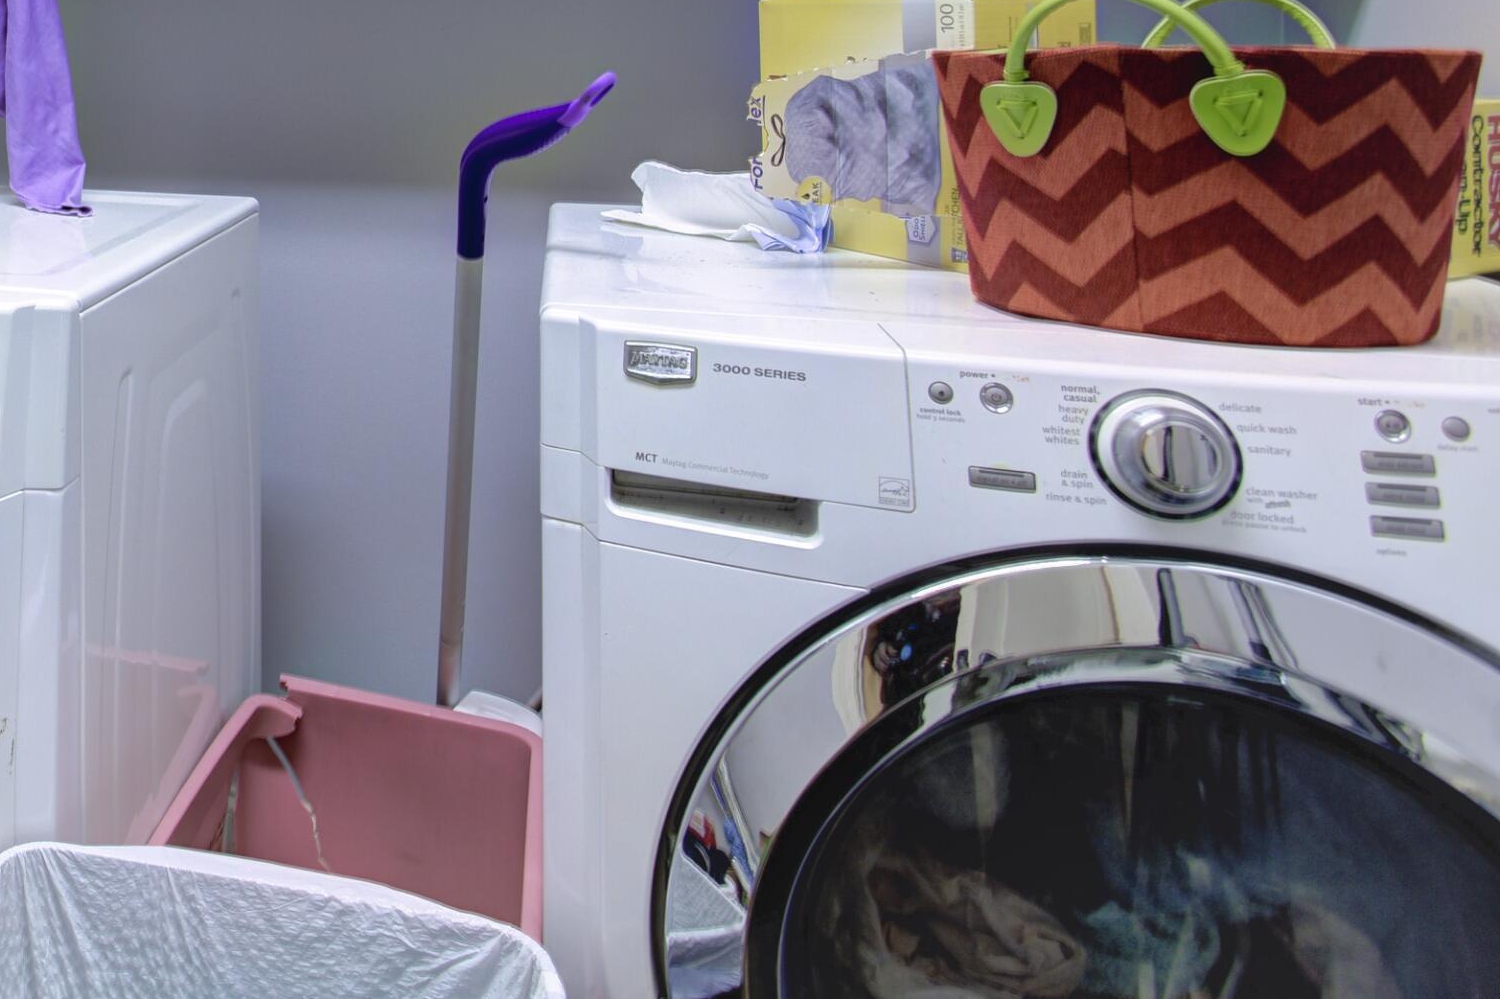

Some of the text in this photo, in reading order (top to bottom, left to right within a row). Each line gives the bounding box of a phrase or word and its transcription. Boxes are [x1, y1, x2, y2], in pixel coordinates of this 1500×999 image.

[939, 3, 955, 33] 100
[1472, 114, 1485, 258] Contractor
[628, 351, 688, 370] MAYTAG
[713, 363, 807, 382] 3000 SERIES
[959, 370, 989, 380] power
[1063, 392, 1097, 403] casual
[1357, 397, 1382, 407] start
[919, 407, 961, 416] control lock
[1058, 404, 1089, 417] heavy
[1218, 401, 1262, 414] delicate
[1061, 413, 1085, 425] duty
[1042, 424, 1081, 436] whitest
[1236, 422, 1297, 436] quick wash
[1044, 434, 1080, 446] whites
[1247, 444, 1291, 457] sanitary
[635, 452, 770, 481] MCT Maytag Commercial Technology
[1060, 468, 1088, 480] drain
[1061, 478, 1093, 490] & spin
[1045, 491, 1107, 506] rinse & spin
[1245, 486, 1318, 501] clean washer
[1230, 510, 1294, 525] door locked
